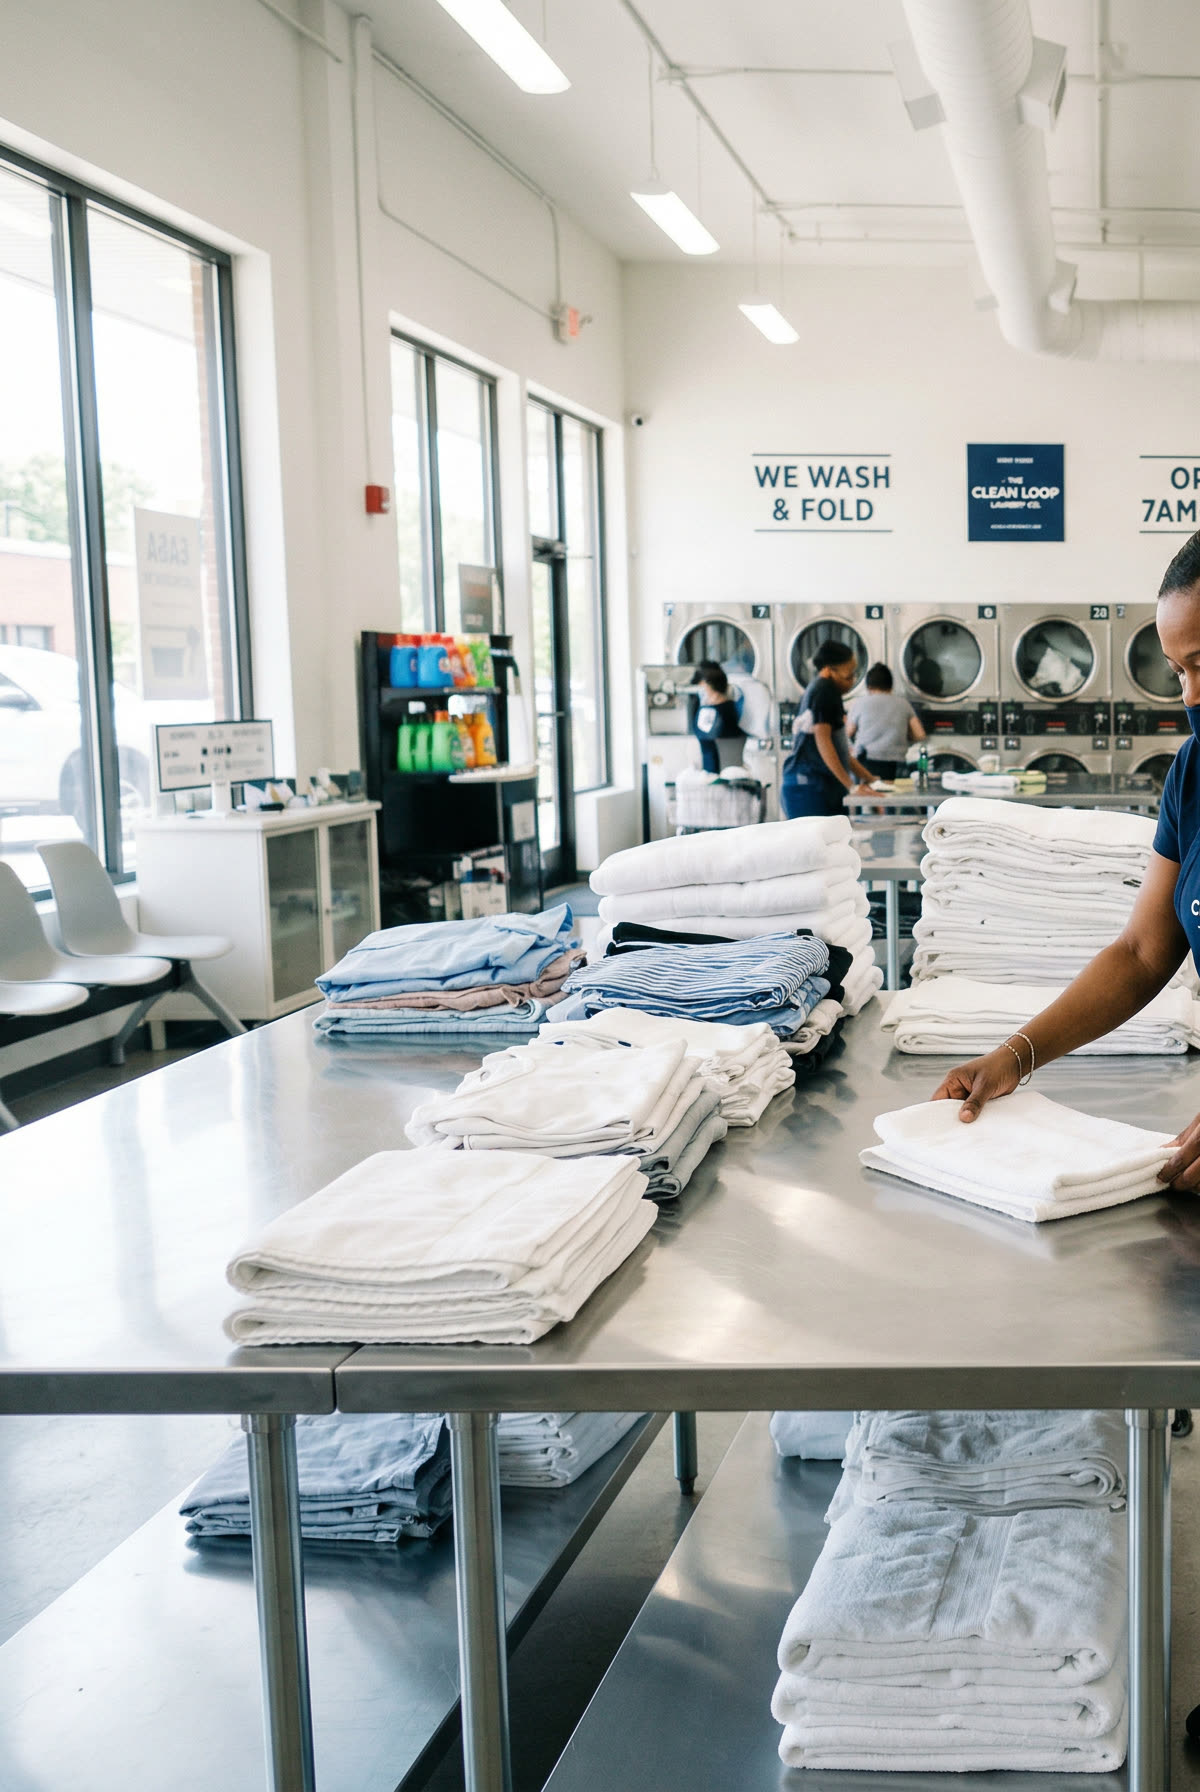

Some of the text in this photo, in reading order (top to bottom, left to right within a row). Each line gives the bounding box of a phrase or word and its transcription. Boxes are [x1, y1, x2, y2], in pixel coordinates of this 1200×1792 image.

[754, 465, 890, 488] WE WASH
[971, 486, 1060, 499] CLEAN LOOP
[772, 498, 874, 521] & FOLD
